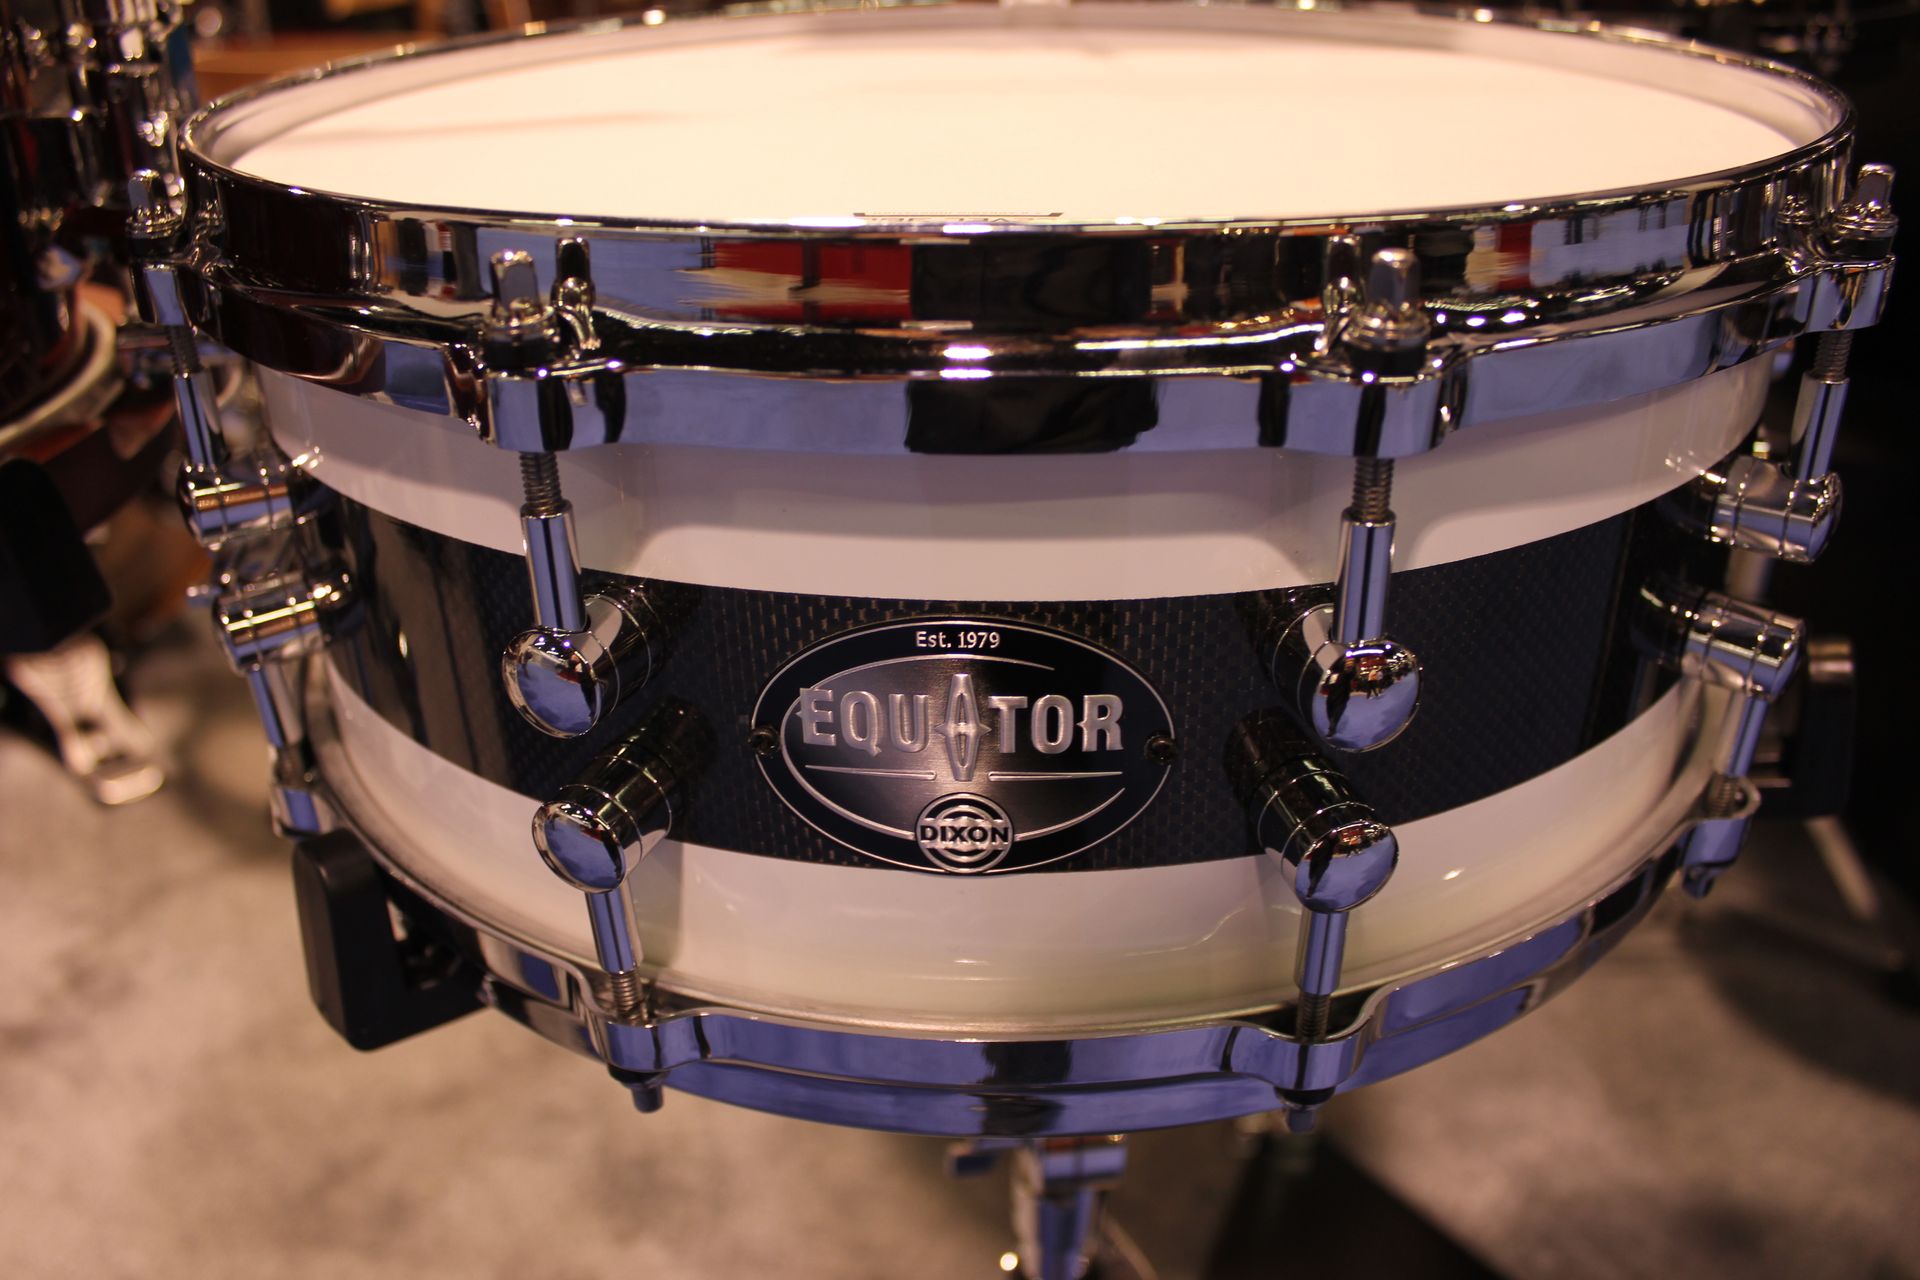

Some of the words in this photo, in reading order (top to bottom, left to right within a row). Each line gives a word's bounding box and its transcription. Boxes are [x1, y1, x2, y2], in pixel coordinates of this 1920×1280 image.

[916, 630, 952, 649] Est.
[957, 631, 1000, 650] 1979
[797, 674, 1124, 781] EQUATOR
[919, 823, 1010, 844] DIXON
